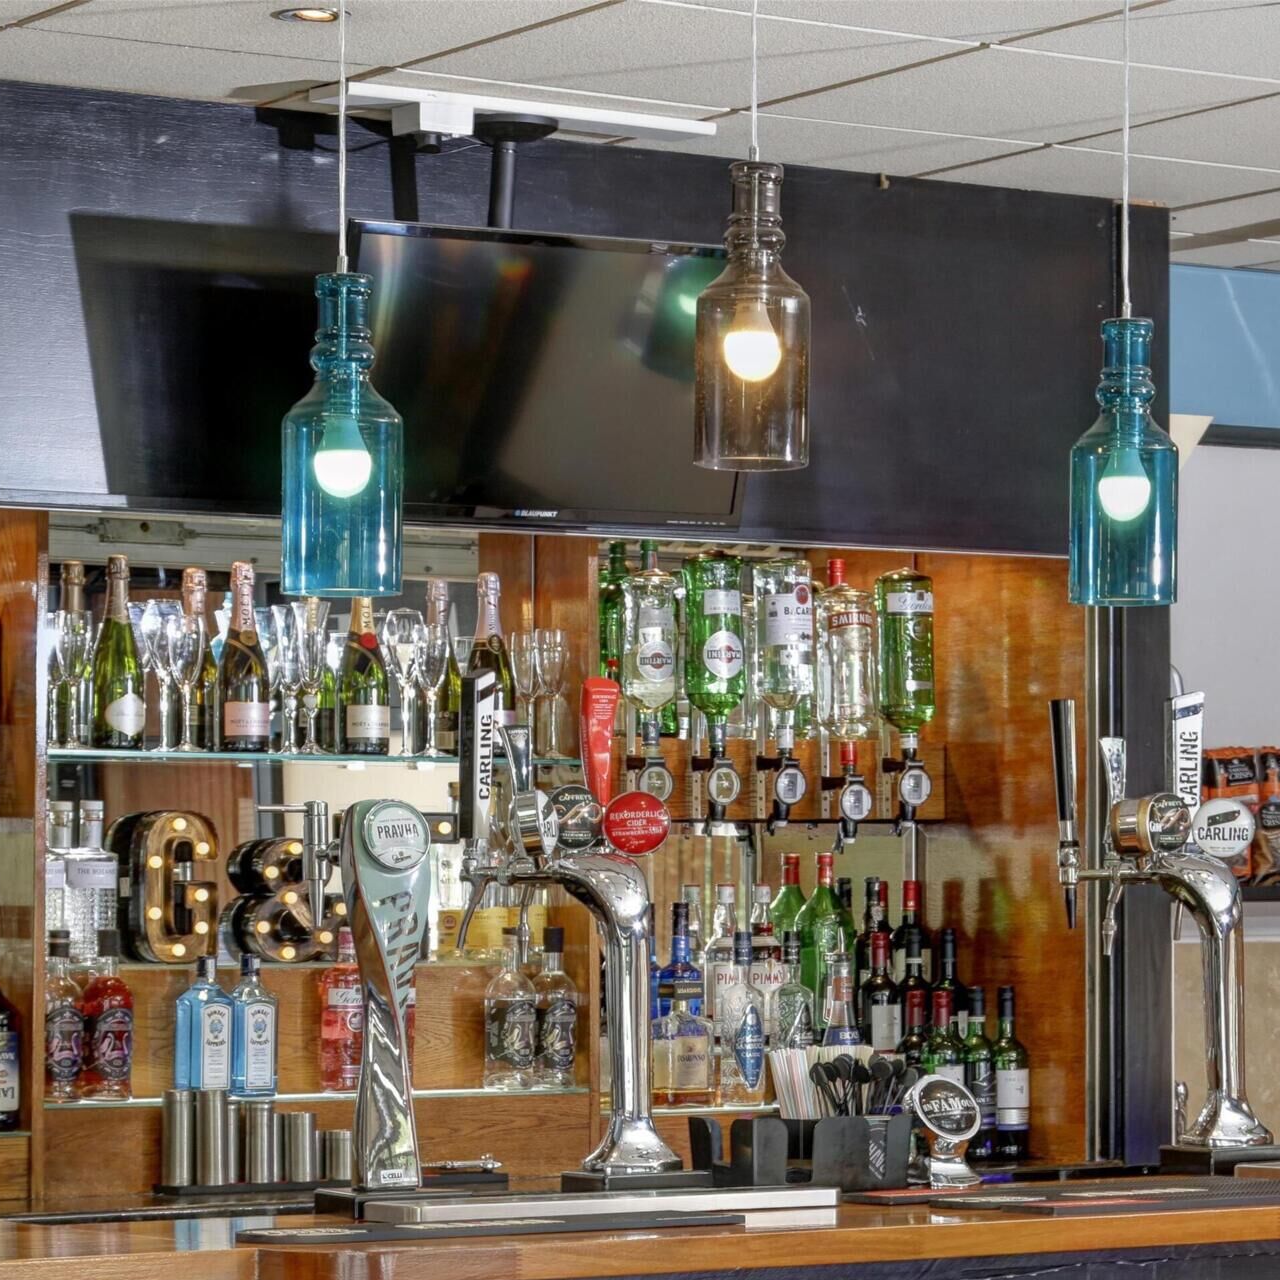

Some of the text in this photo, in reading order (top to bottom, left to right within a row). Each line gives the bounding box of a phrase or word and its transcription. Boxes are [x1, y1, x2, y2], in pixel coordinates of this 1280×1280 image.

[641, 656, 672, 665] MARTINI
[707, 649, 741, 659] MARTINI
[477, 713, 493, 801] CARLING
[1179, 731, 1199, 808] CARLING
[377, 824, 420, 839] PRAVHA
[1198, 827, 1249, 842] CARLING
[132, 810, 218, 963] G
